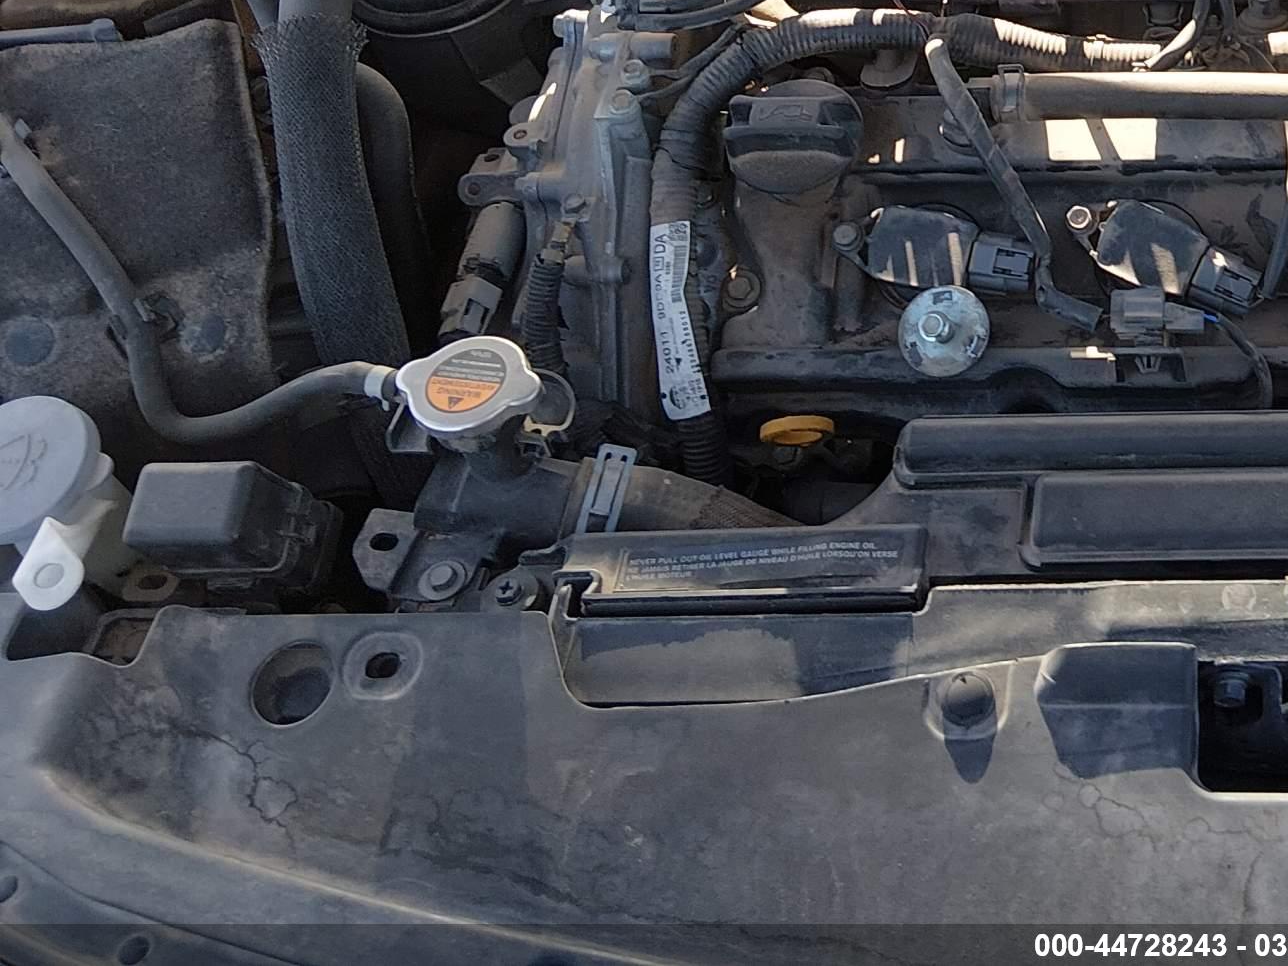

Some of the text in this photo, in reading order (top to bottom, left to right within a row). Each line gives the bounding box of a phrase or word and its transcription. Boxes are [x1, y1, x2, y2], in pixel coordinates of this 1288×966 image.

[630, 557, 656, 565] NEVER
[680, 555, 697, 563] OUT
[714, 551, 738, 560] LEVEL
[741, 548, 769, 558] GAUGE
[771, 546, 795, 555] WHILE
[797, 543, 827, 553] FILLING
[829, 541, 860, 549] ENGINE
[706, 561, 717, 569] LA
[872, 550, 898, 558] VERSE
